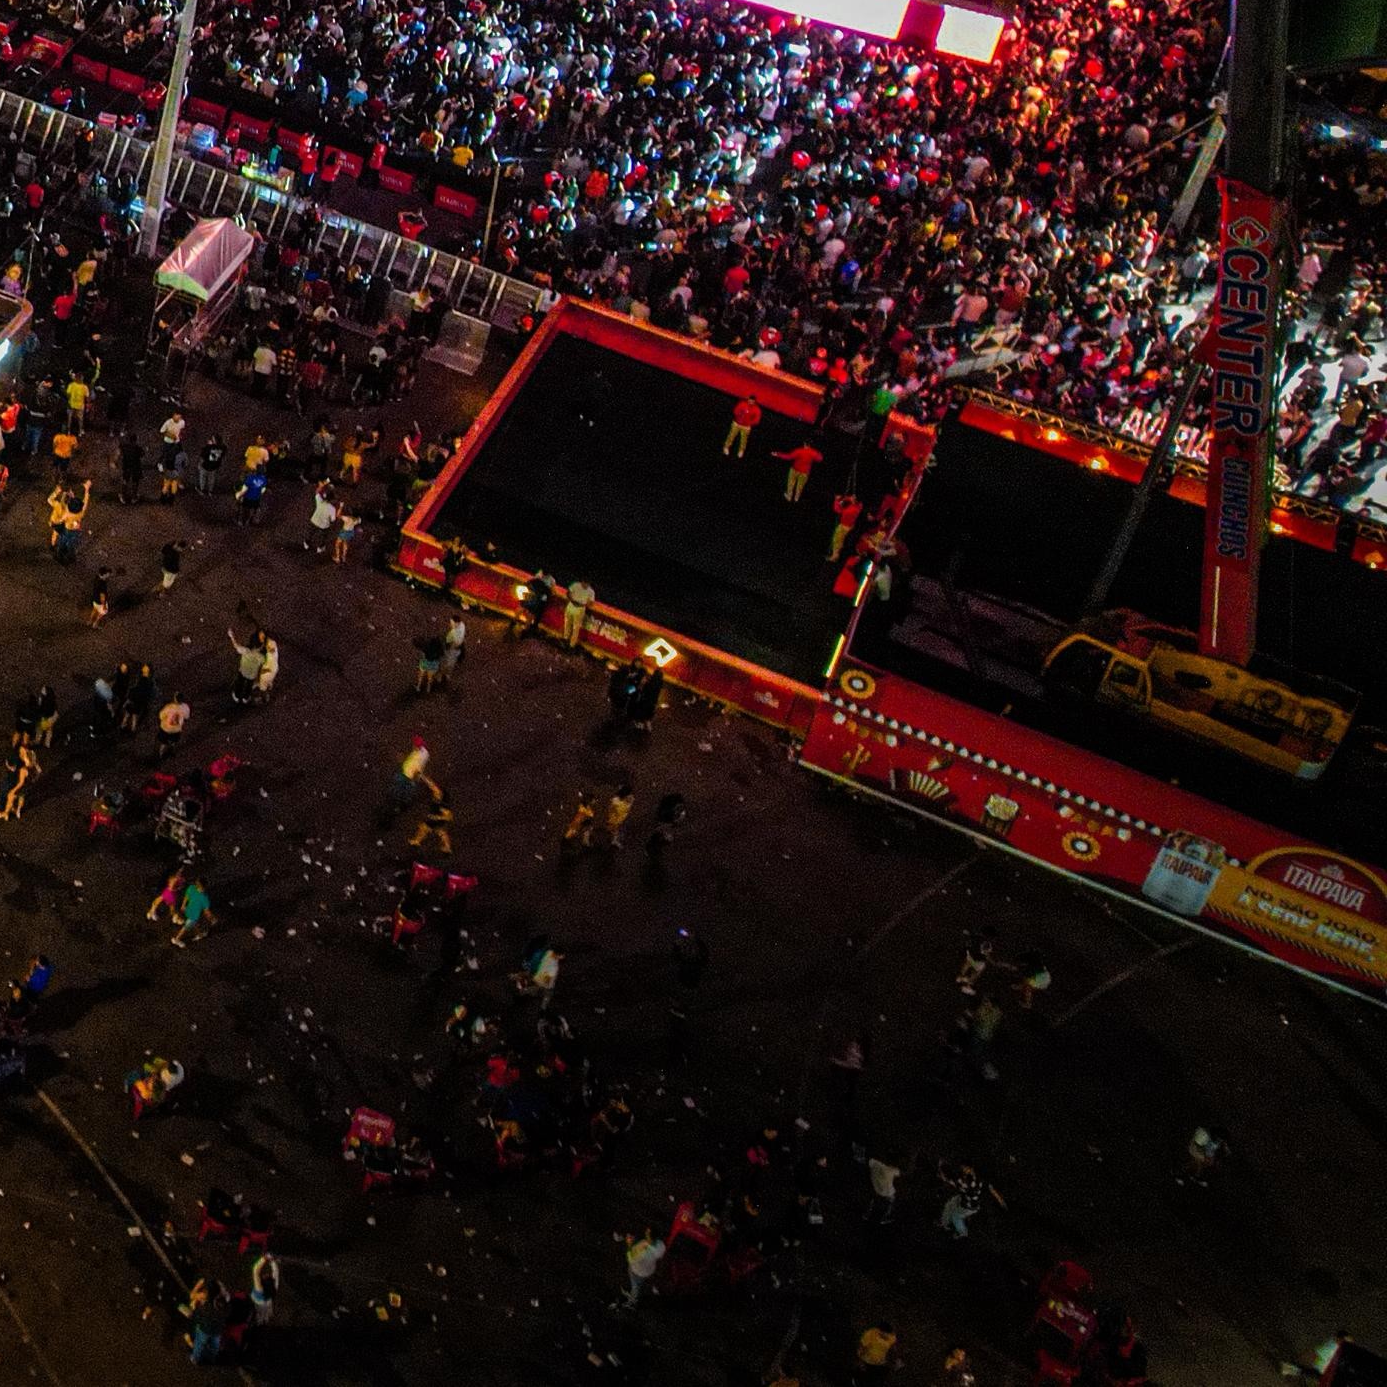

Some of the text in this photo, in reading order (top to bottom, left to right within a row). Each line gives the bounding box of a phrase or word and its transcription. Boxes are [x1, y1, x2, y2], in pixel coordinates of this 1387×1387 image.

[1214, 247, 1270, 437] CENTER
[1217, 458, 1251, 560] GUINCHOS
[1282, 863, 1366, 912] ITAIPAVA
